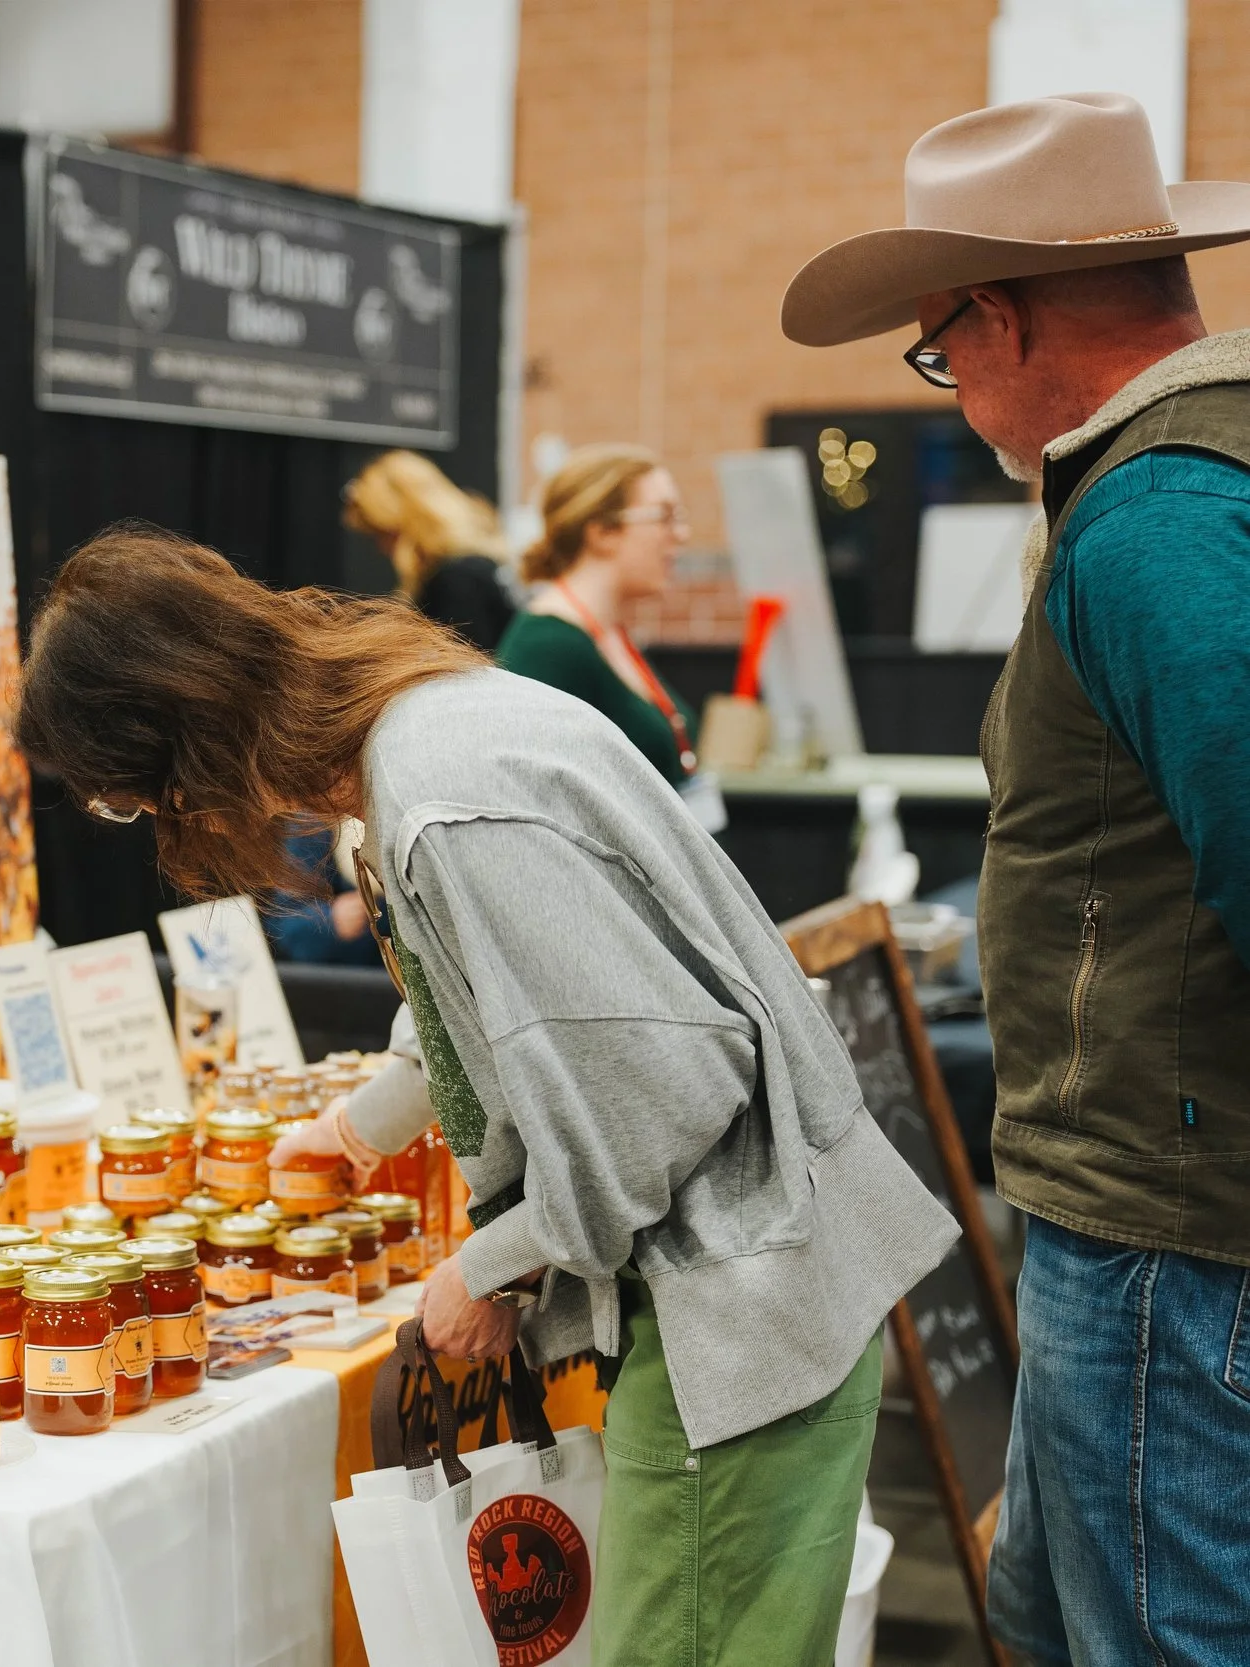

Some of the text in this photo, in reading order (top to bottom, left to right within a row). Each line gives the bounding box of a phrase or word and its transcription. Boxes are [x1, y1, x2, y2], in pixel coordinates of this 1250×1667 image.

[469, 1499, 581, 1591] RED ROCK REGION
[486, 1566, 577, 1620] hocolate
[514, 1608, 523, 1621] &
[518, 1614, 545, 1637] foods
[498, 1628, 568, 1667] ESTIVAL
